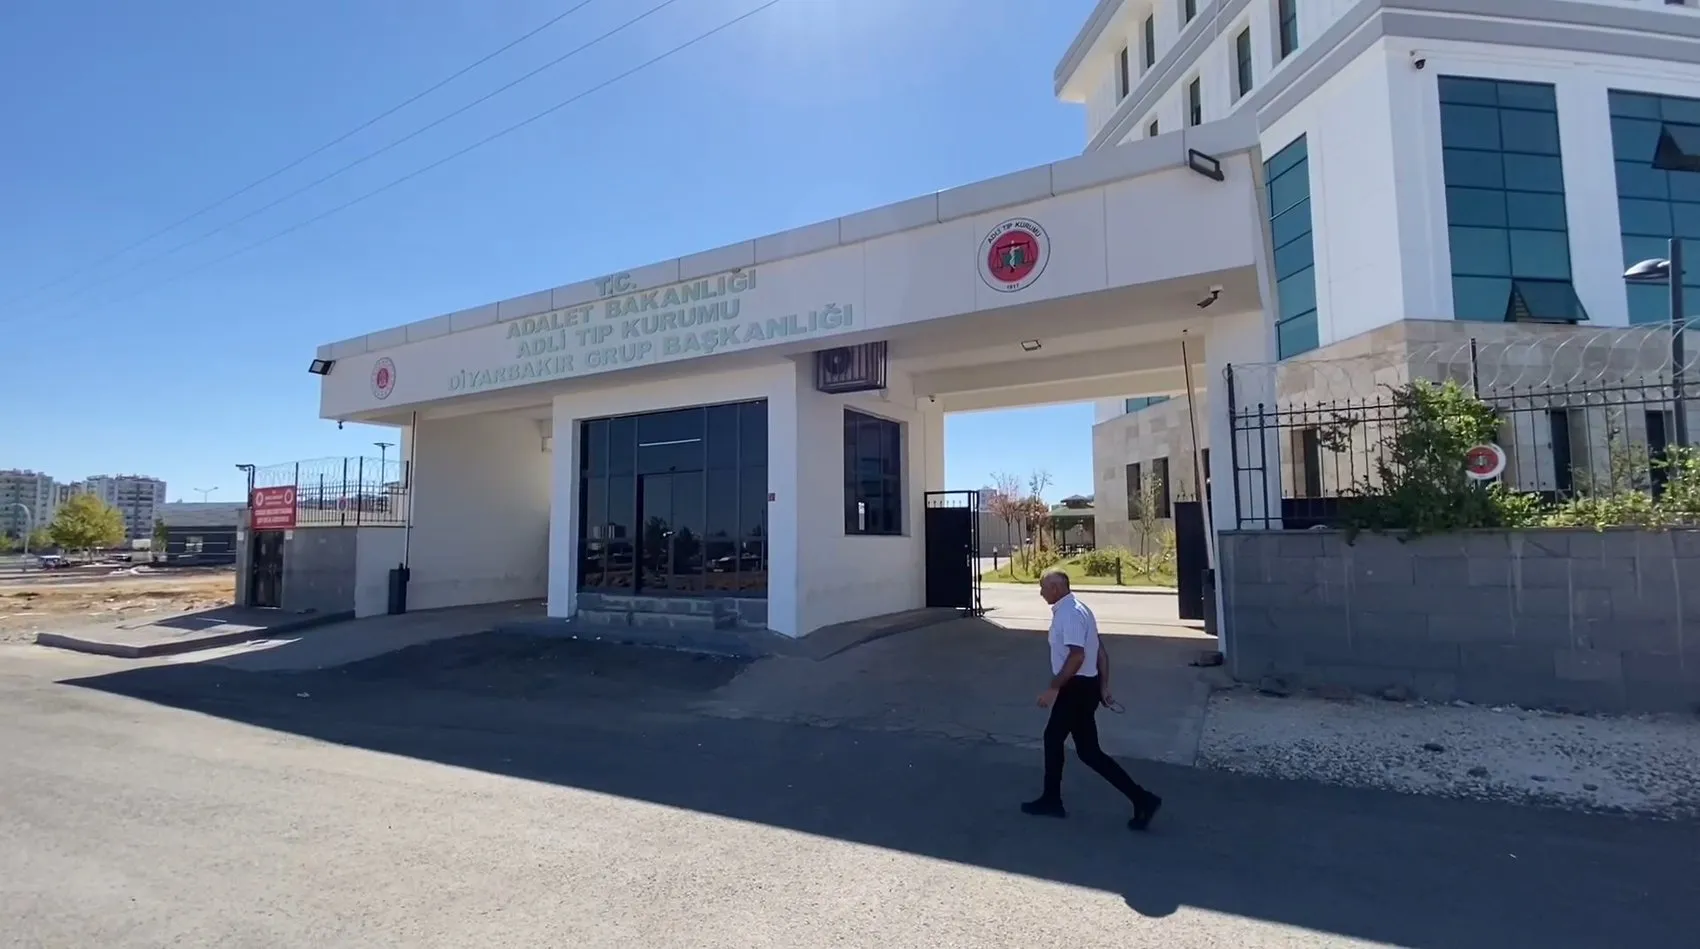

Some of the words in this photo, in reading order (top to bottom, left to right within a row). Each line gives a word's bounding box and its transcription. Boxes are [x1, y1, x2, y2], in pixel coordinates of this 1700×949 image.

[1015, 222, 1041, 238] KURUMU
[505, 304, 595, 340] ADALET
[604, 268, 756, 319] BAKANLIĞI
[516, 329, 567, 359] ADLİ
[575, 324, 614, 347] TIP
[621, 298, 741, 340] KURUMU
[448, 353, 575, 392] DİYARBAKIR
[586, 340, 653, 370] GRUP
[662, 302, 854, 356] BAŞKANLIĞI
